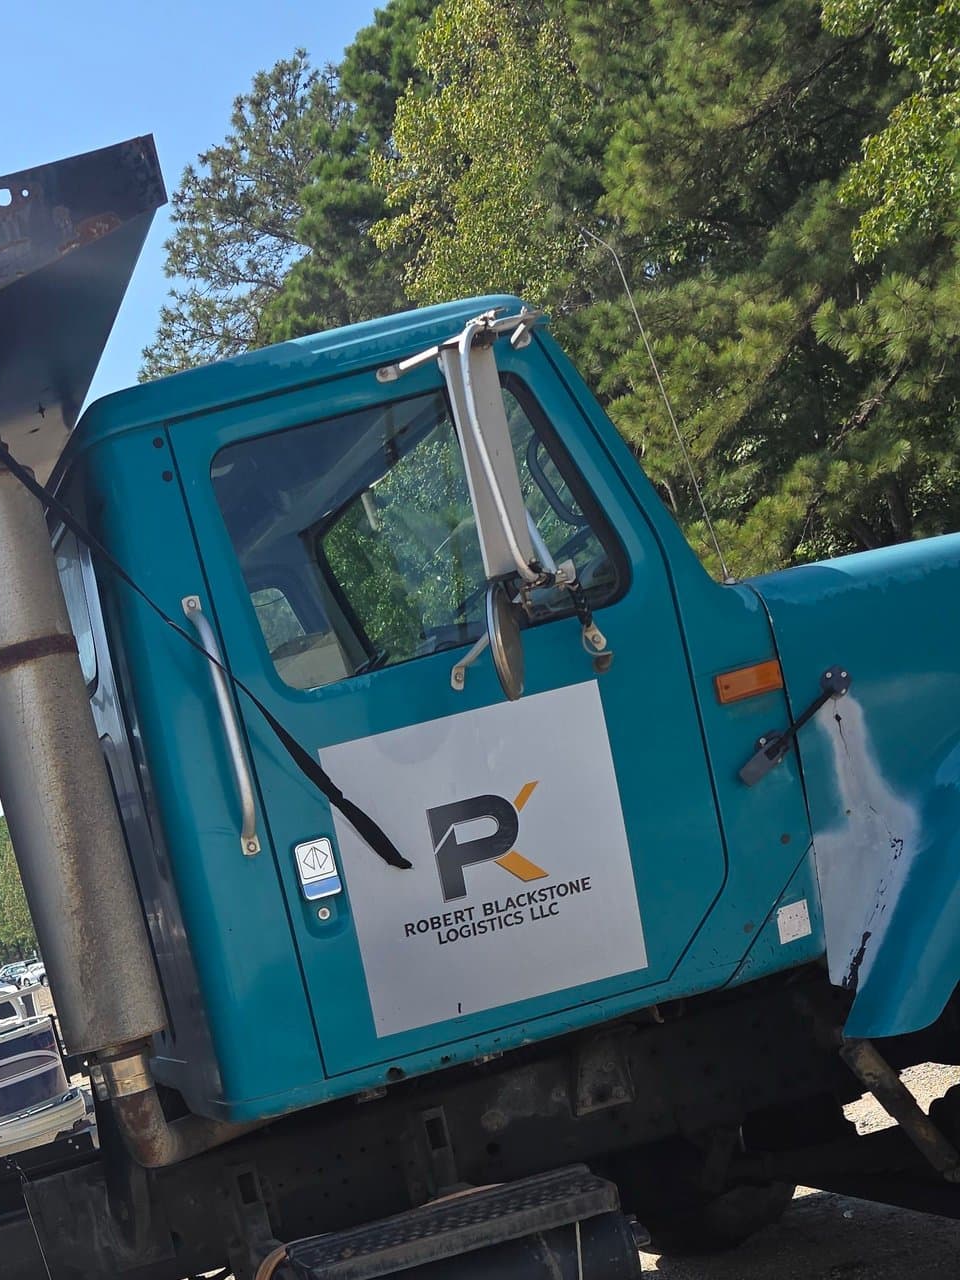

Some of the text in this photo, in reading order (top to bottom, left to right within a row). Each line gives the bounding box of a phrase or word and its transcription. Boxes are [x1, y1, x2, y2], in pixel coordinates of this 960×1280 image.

[404, 876, 592, 937] ROBERT BLACKSTONE
[437, 902, 560, 945] LOGISTICS LLC
